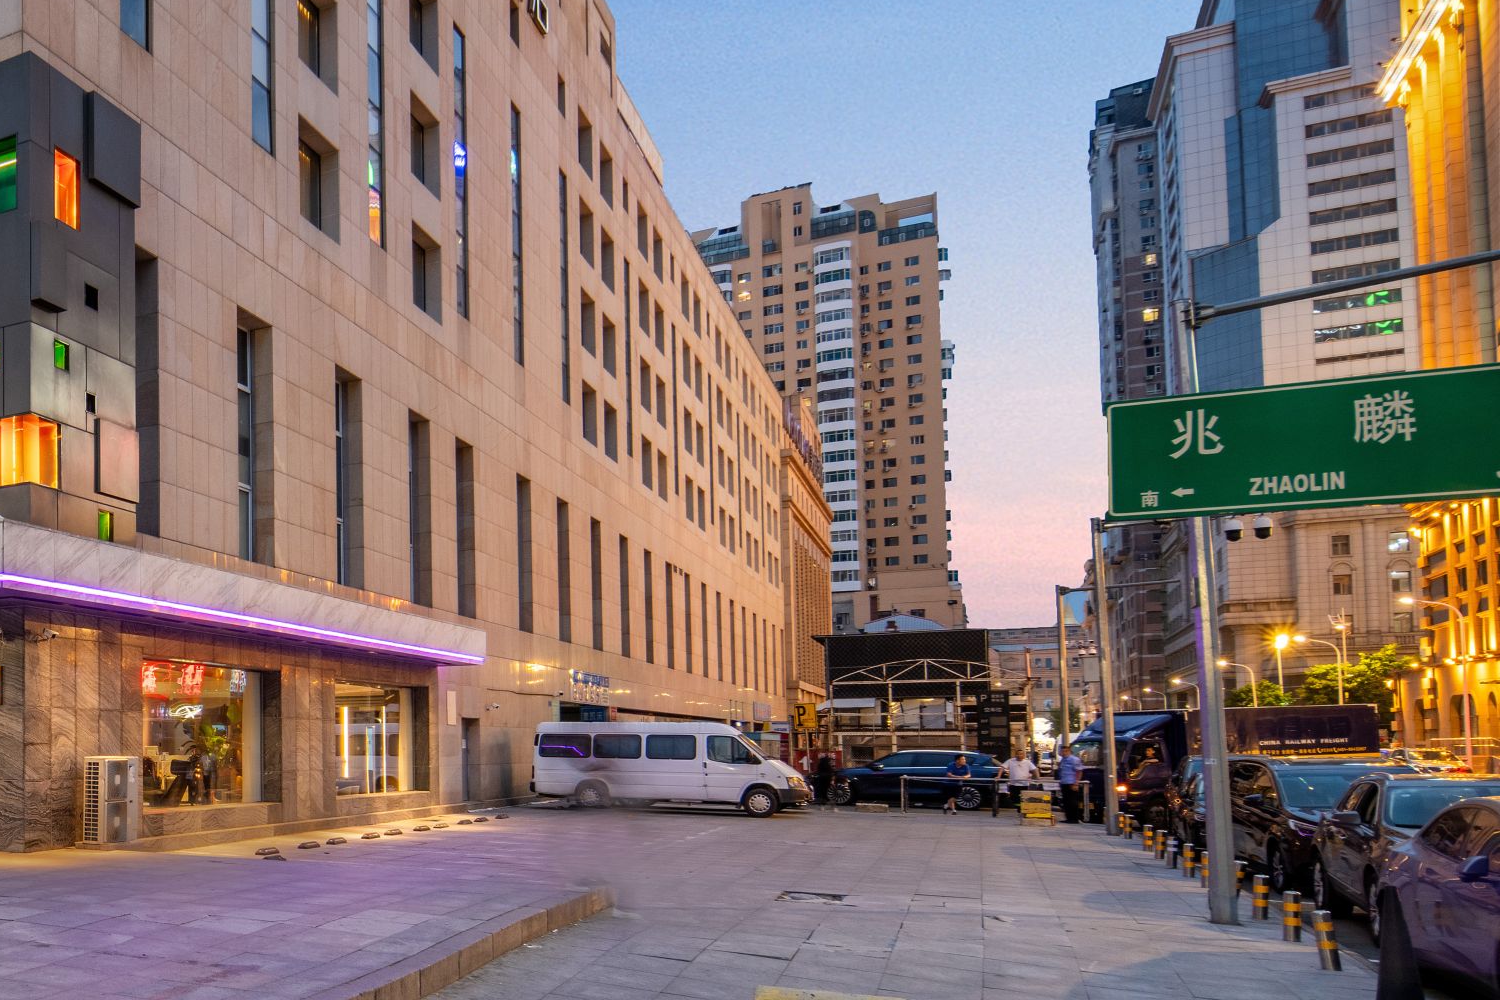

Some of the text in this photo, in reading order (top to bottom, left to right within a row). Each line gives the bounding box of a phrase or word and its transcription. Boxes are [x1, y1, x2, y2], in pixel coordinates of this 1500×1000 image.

[1249, 471, 1345, 496] ZHAOLIN
[1140, 490, 1160, 508] 南
[795, 706, 806, 726] P
